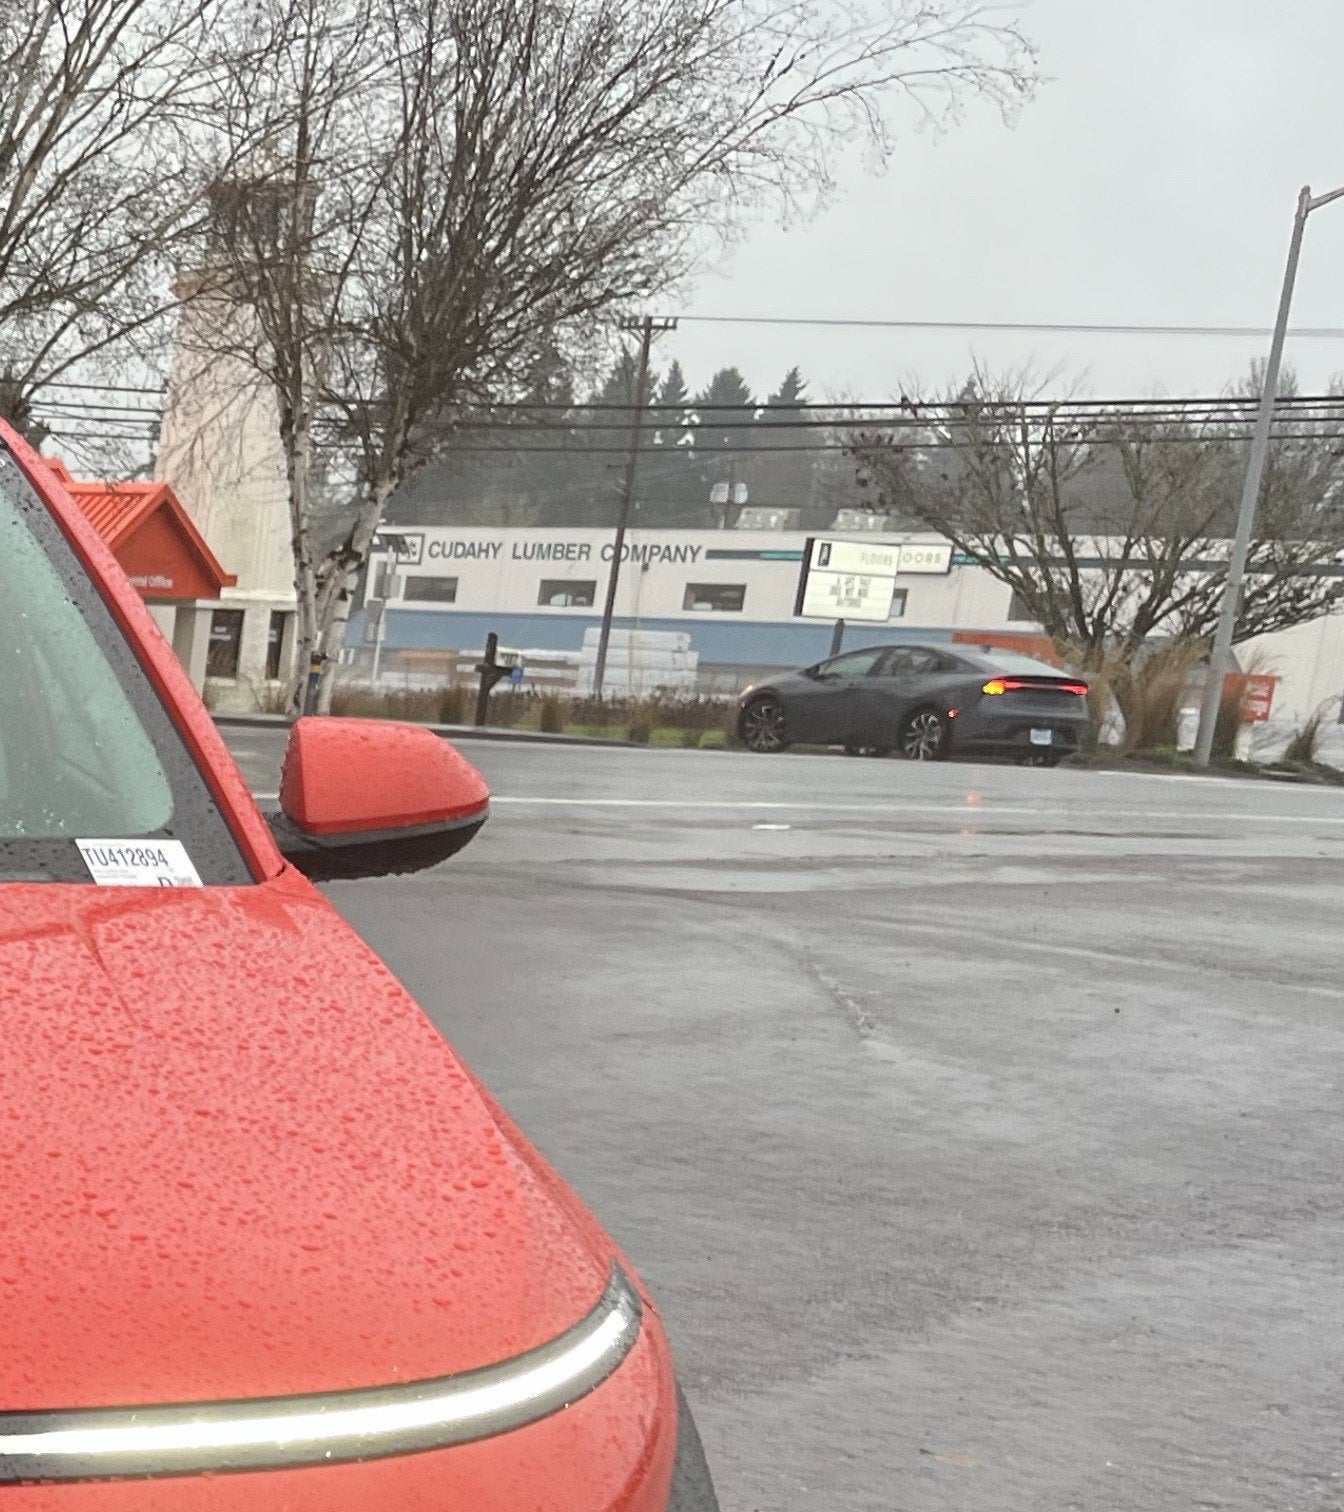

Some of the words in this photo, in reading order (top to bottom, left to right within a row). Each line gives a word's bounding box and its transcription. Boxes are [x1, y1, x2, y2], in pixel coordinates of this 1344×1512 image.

[428, 541, 502, 559] CUDAHY
[512, 542, 591, 561] LUMBER
[600, 543, 703, 563] COMPANY
[82, 848, 169, 867] TU412894
